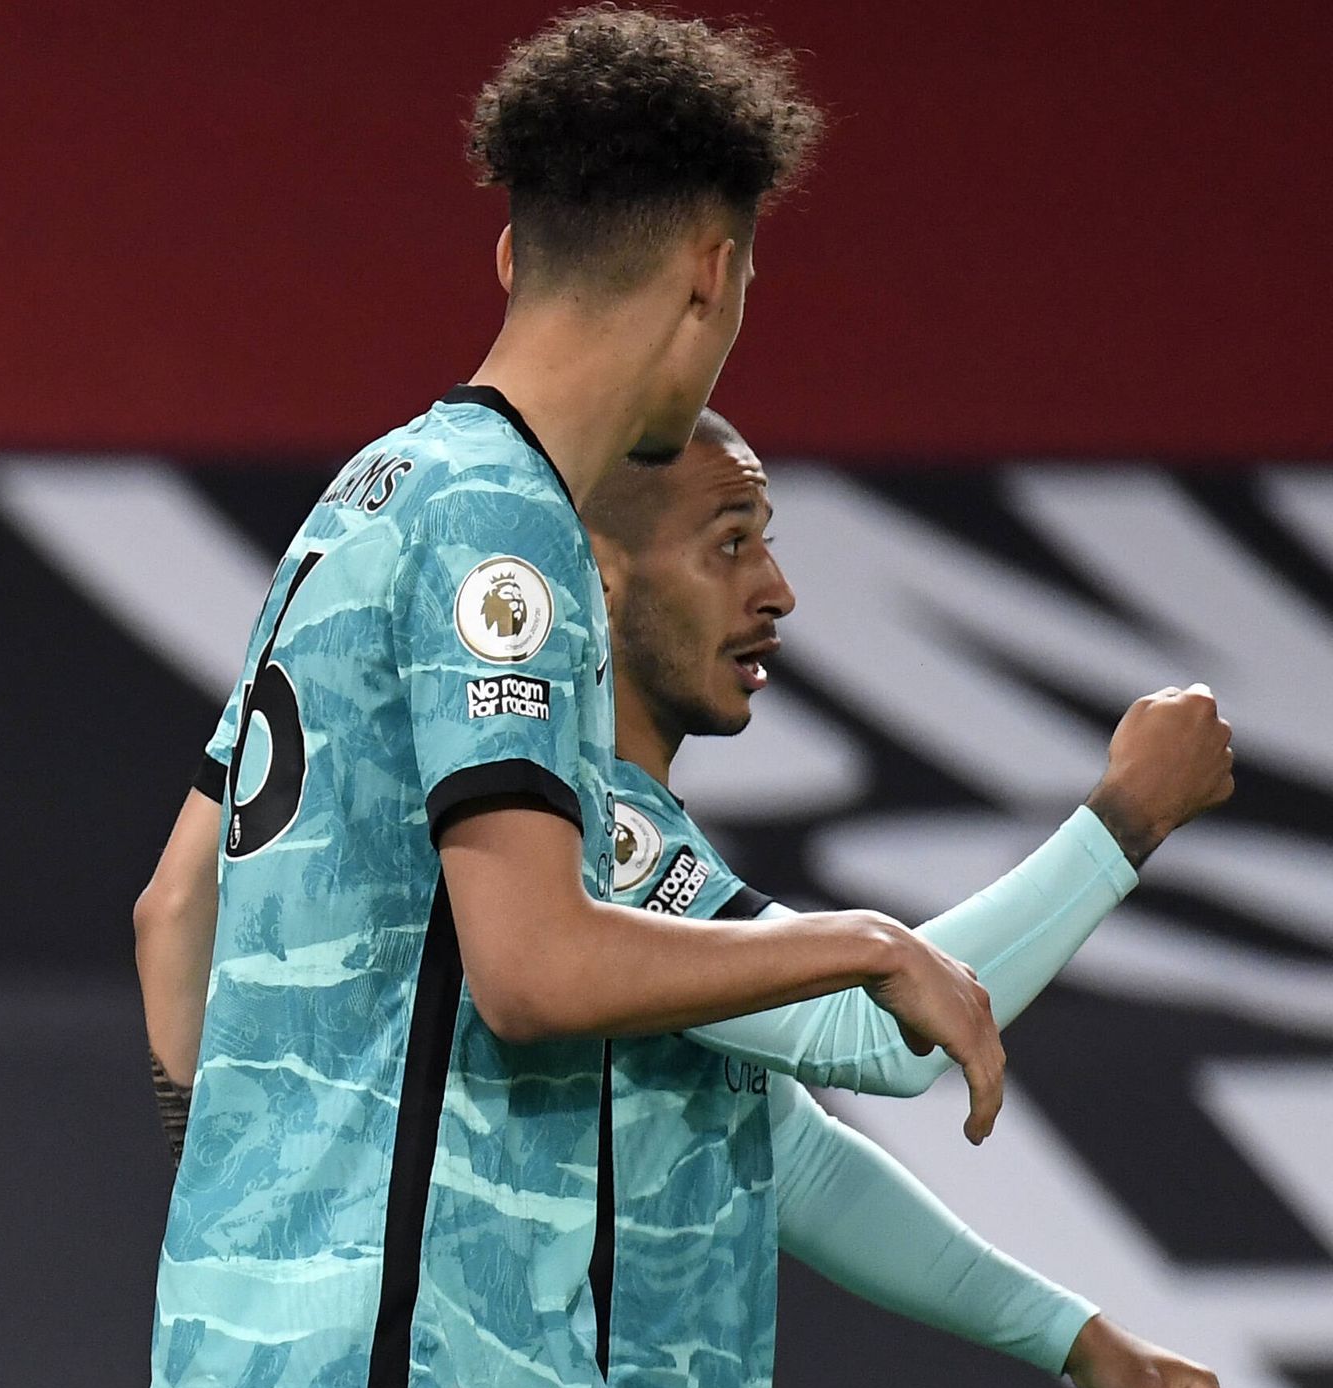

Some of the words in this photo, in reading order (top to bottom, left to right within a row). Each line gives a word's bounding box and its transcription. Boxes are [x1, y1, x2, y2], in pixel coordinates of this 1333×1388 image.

[466, 680, 499, 701] No
[502, 677, 543, 701] room
[502, 695, 549, 720] racism
[656, 853, 695, 902] room
